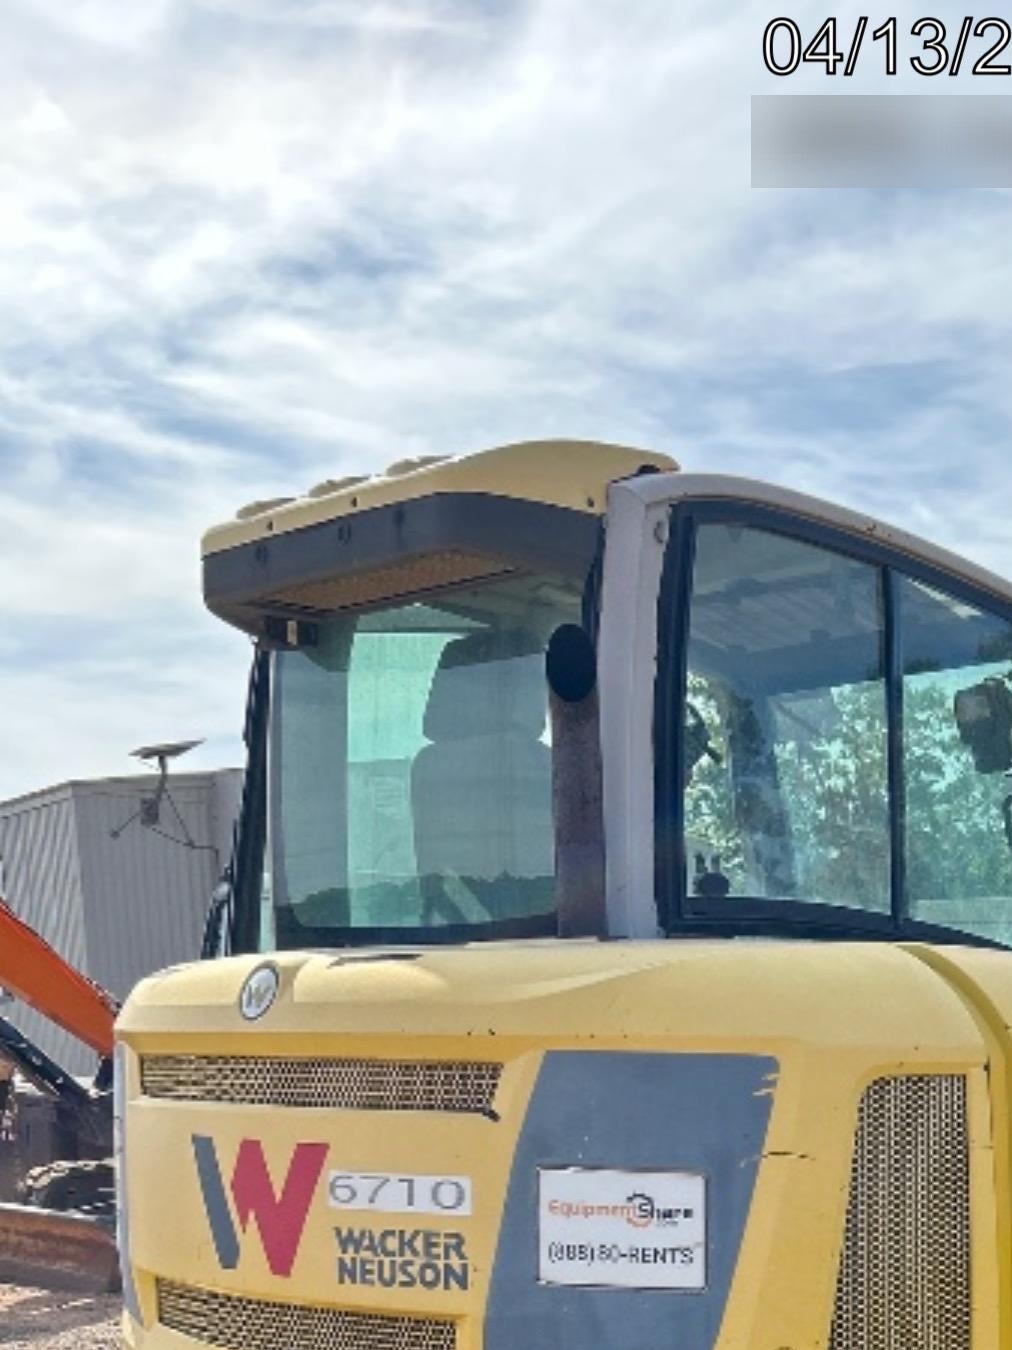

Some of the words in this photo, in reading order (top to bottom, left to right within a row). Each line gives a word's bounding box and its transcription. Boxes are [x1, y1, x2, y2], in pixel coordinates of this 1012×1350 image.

[328, 1174, 466, 1210] 6710
[332, 1226, 469, 1261] WACKER
[337, 1256, 469, 1291] NEUSON
